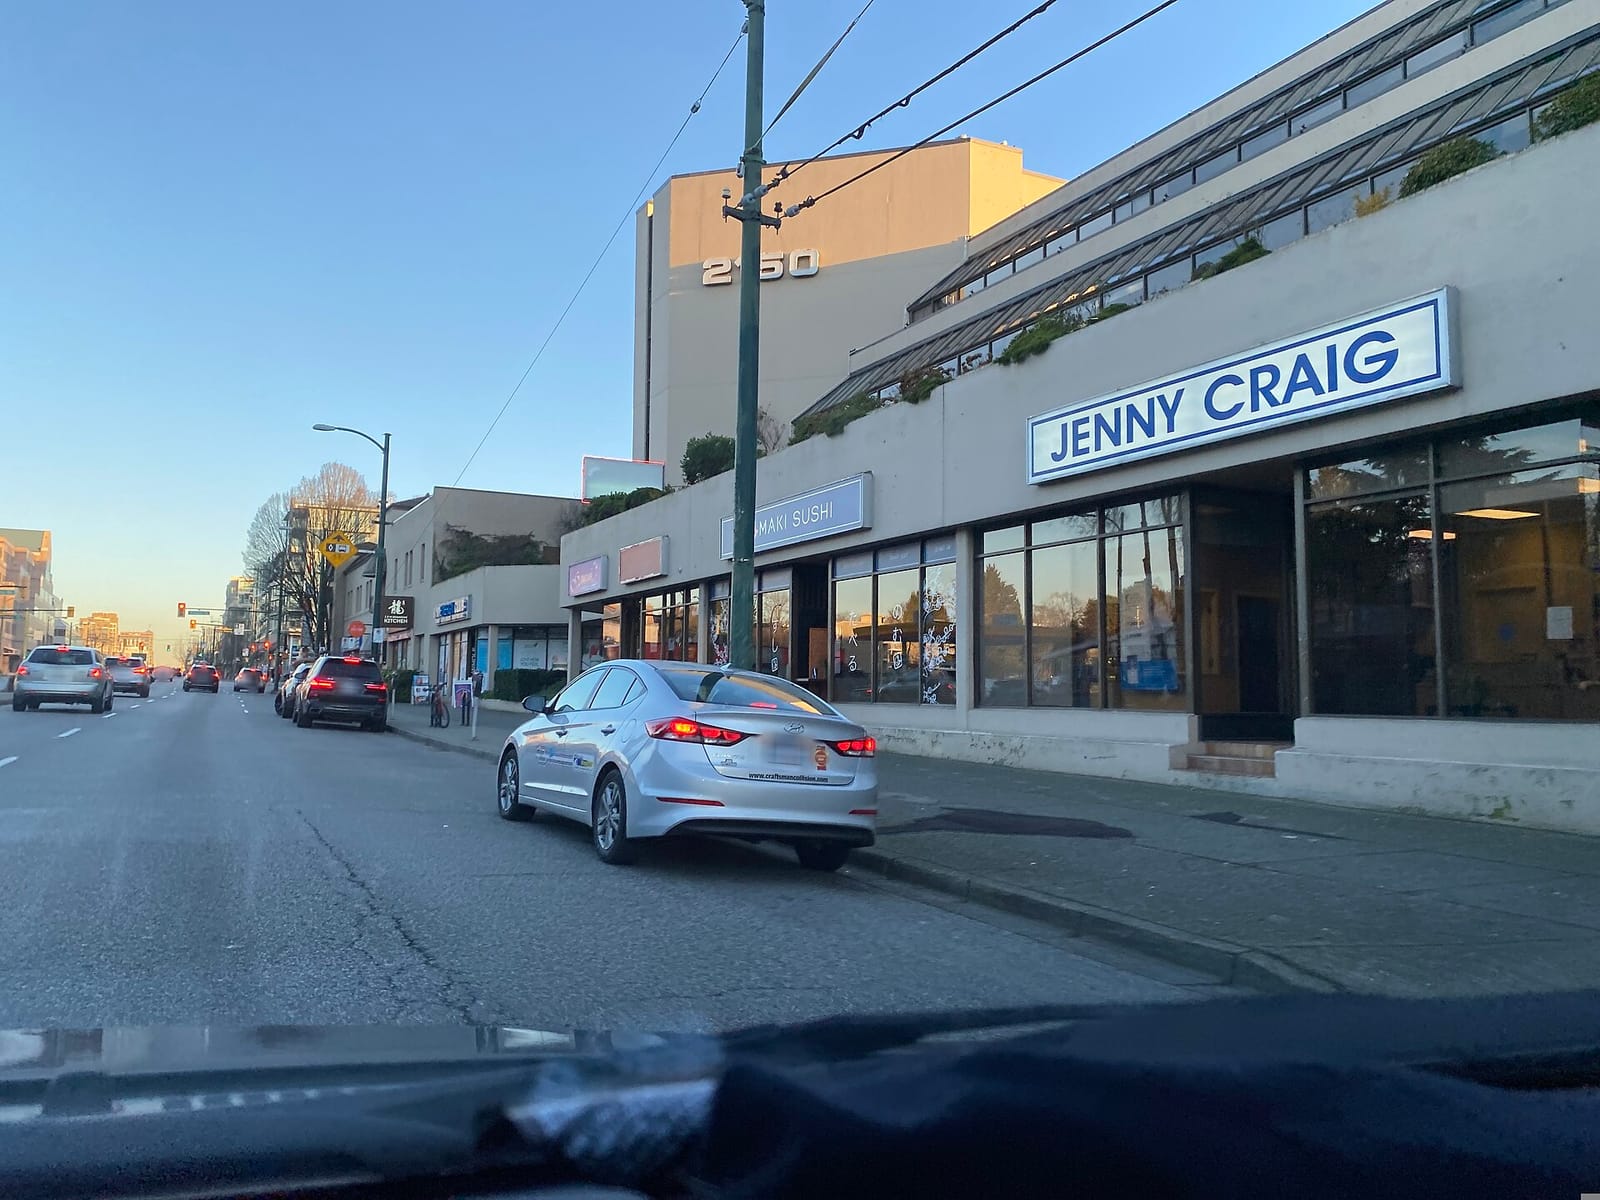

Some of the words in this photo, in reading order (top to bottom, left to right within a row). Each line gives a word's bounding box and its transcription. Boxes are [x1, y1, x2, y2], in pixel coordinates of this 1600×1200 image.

[702, 248, 819, 285] 250
[1050, 387, 1185, 463] JENNY
[1203, 331, 1399, 421] CRAIG
[755, 513, 787, 537] MAKI
[792, 501, 833, 528] SUSHI
